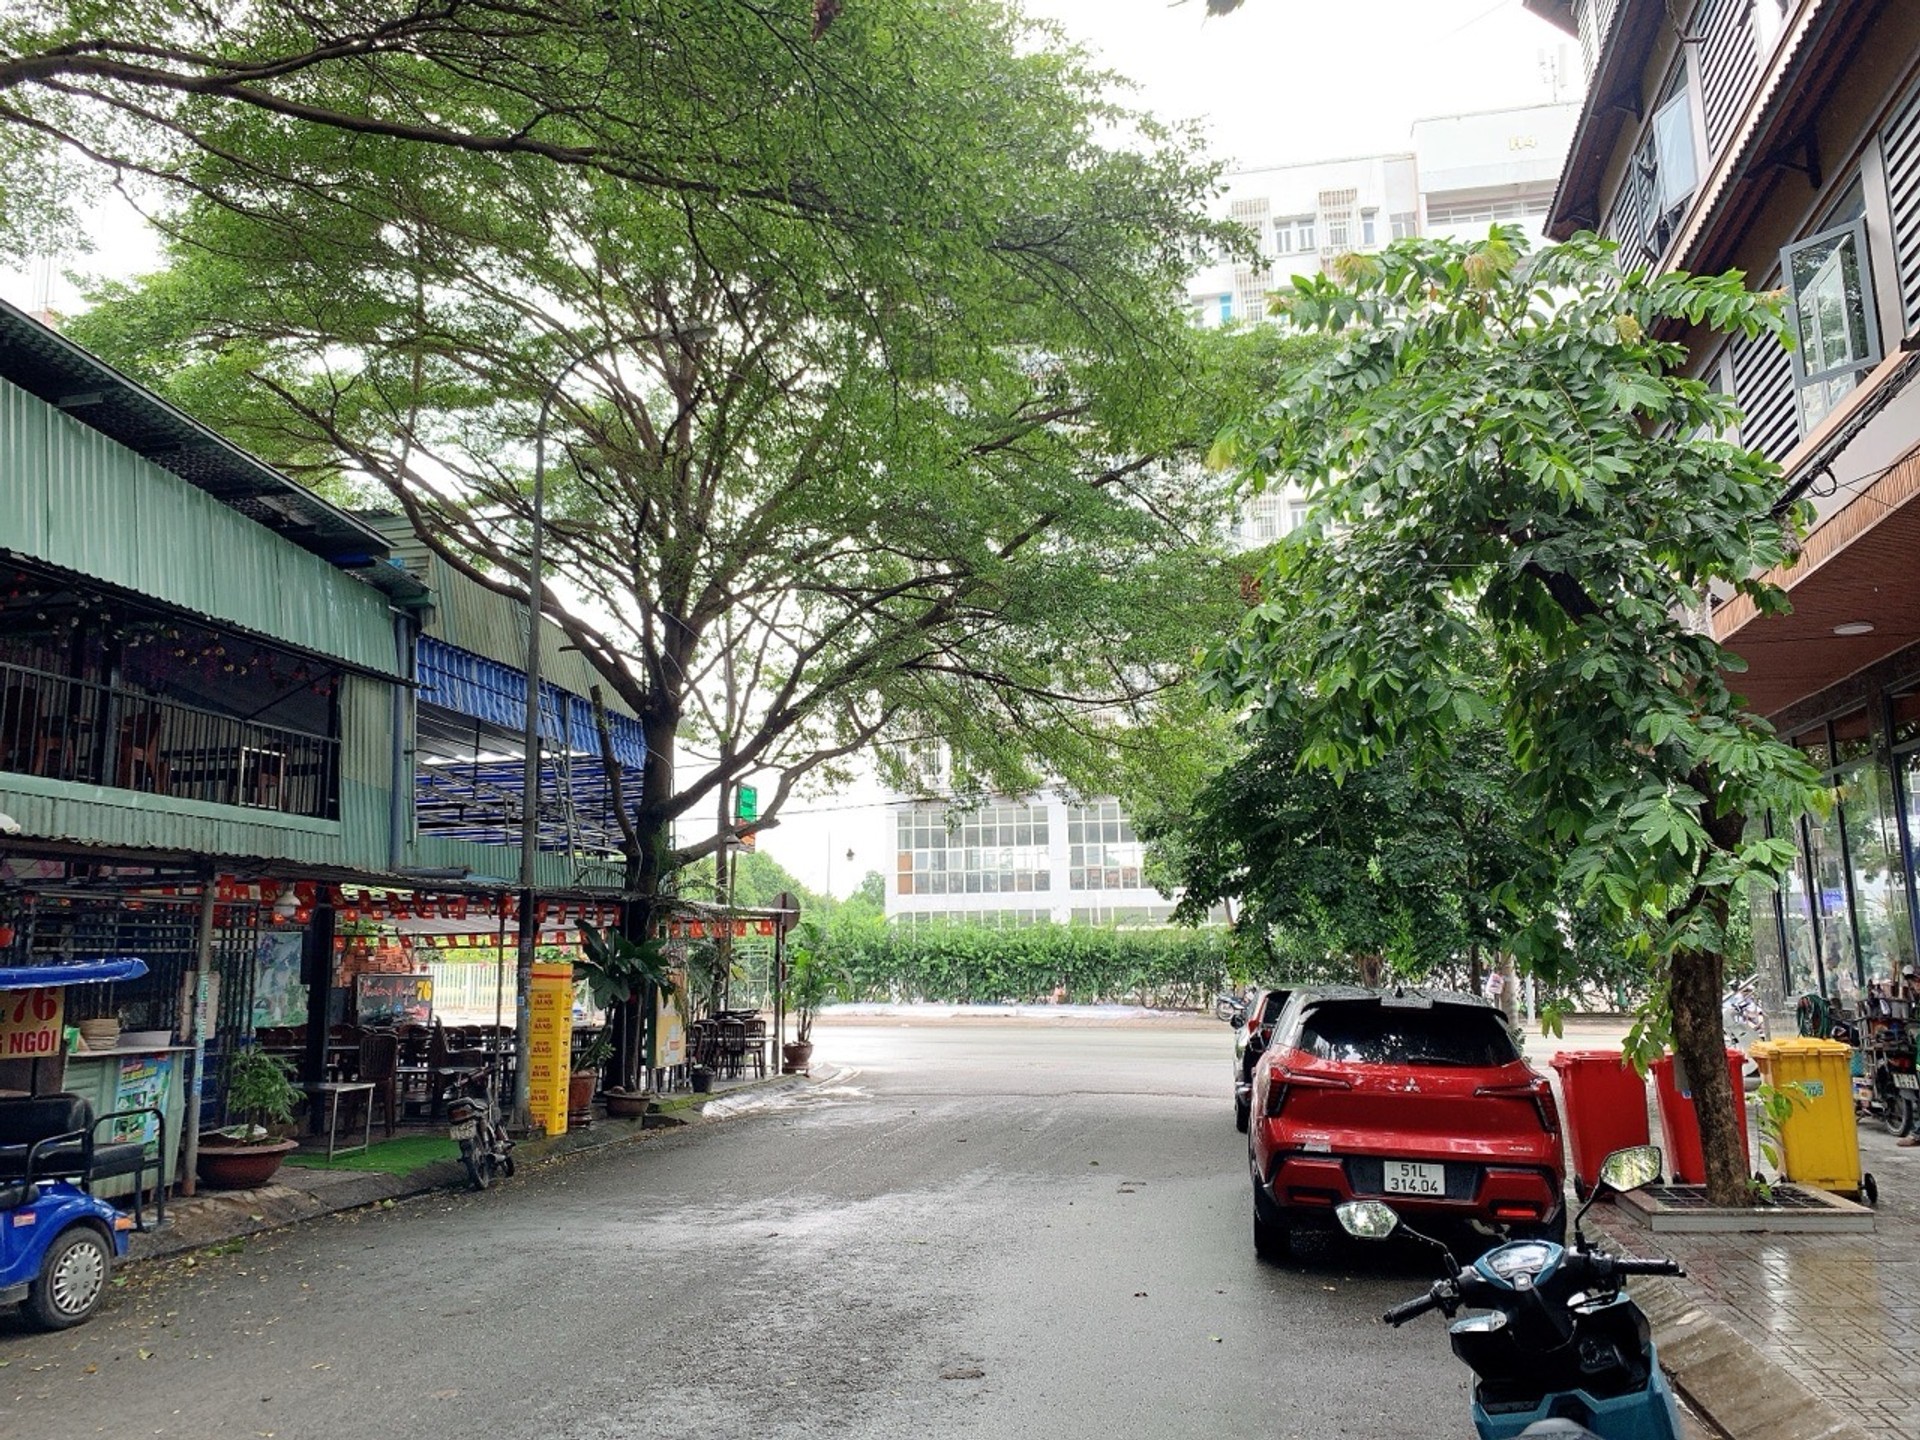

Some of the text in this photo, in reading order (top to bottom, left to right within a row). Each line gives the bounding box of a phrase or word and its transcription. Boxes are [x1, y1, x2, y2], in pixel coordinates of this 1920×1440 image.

[416, 980, 432, 1001] 76
[10, 987, 57, 1023] 76
[9, 1026, 57, 1054] NGÓI
[1401, 1164, 1427, 1178] 51L
[1390, 1177, 1438, 1193] 314.04
